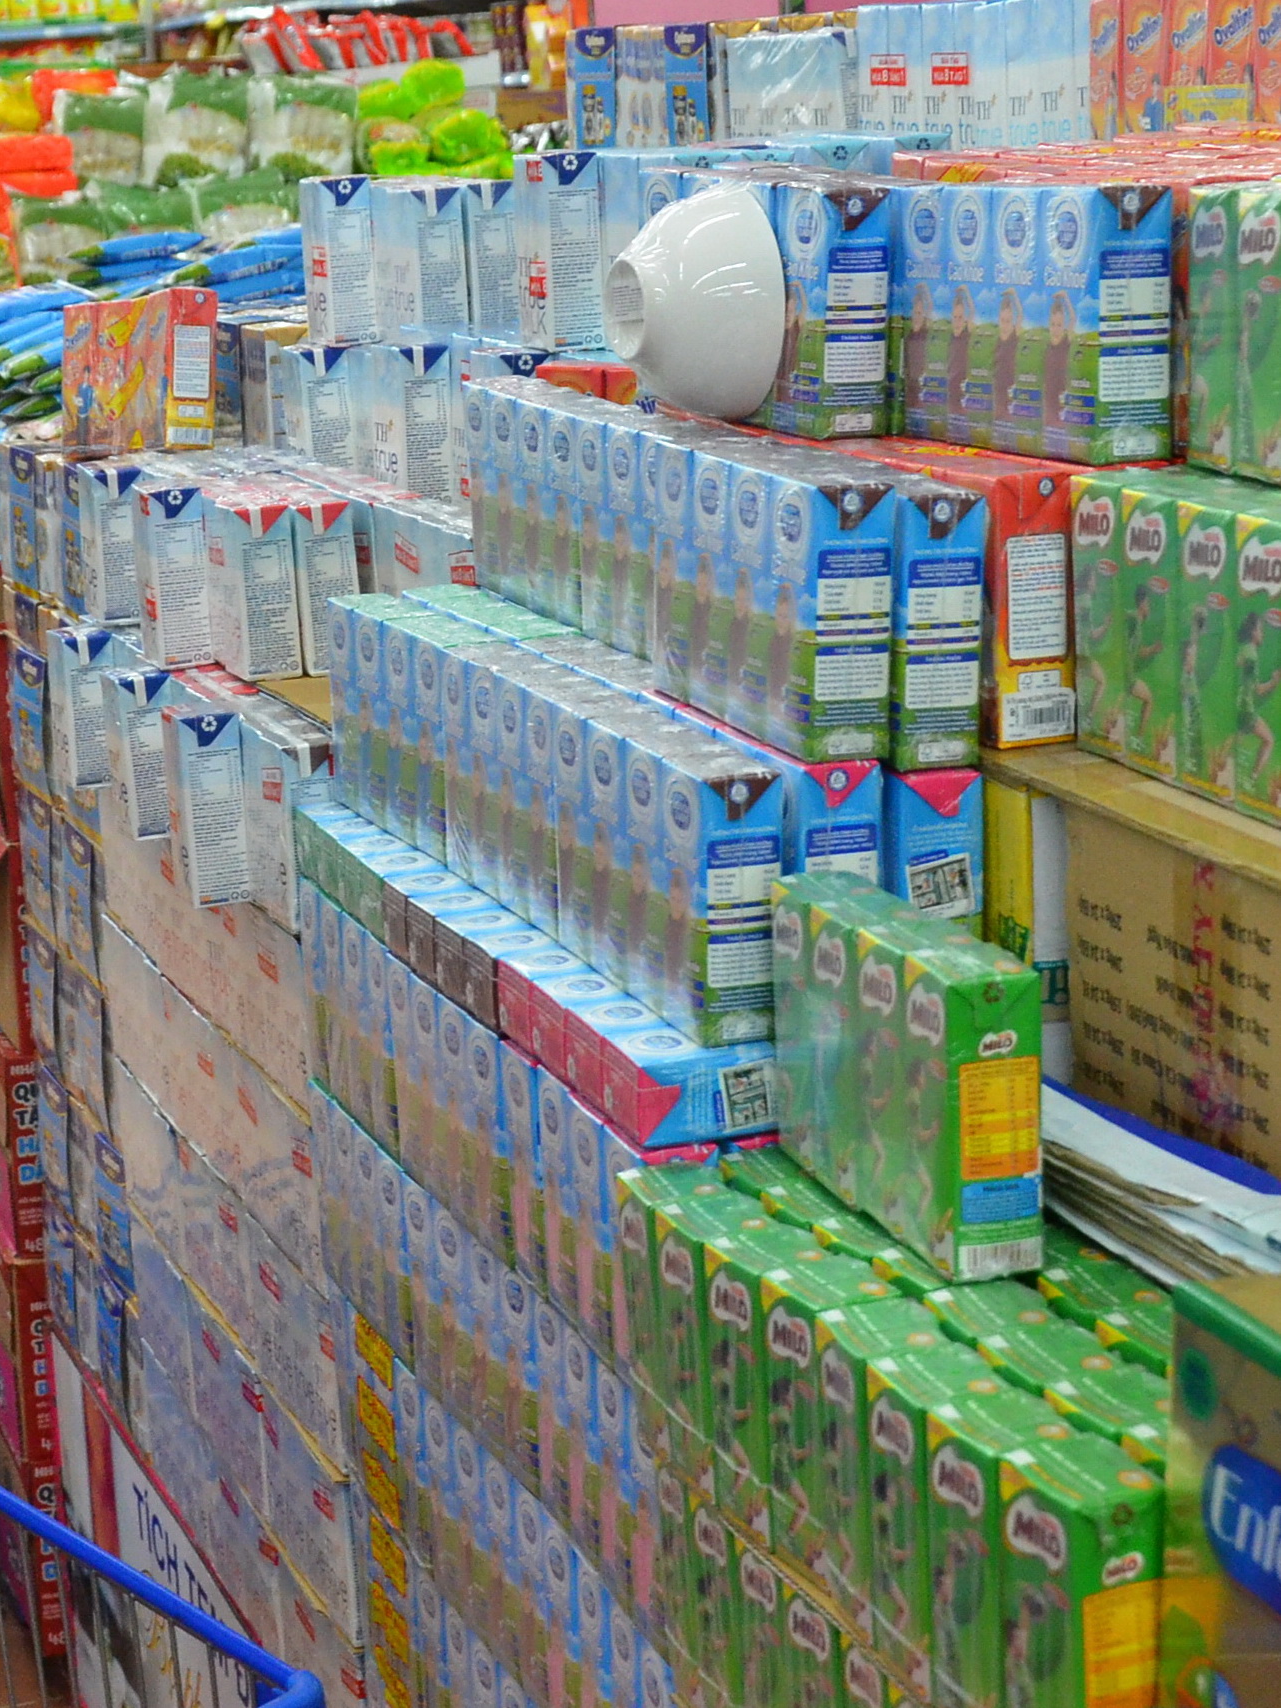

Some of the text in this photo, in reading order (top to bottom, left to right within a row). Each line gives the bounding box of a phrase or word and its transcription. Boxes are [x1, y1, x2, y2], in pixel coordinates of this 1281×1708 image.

[1127, 13, 1163, 53] Ovaltine
[1214, 6, 1254, 47] Ovaltine
[893, 95, 907, 114] TH
[925, 95, 940, 115] TH
[1010, 96, 1026, 116] TH
[1041, 91, 1058, 112] TH
[1077, 86, 1087, 107] T
[976, 100, 991, 120] TH
[1240, 227, 1276, 255] MILO
[375, 422, 389, 443] TH
[374, 448, 399, 474] true
[1079, 512, 1110, 536] MILO
[1130, 527, 1161, 552] MILO
[1188, 541, 1220, 567] MILO
[861, 975, 892, 1005] MILO
[983, 1036, 1013, 1052] MILO
[714, 1285, 748, 1323] MILO
[772, 1319, 808, 1360] MILO
[938, 1460, 979, 1508] MILO
[1013, 1510, 1061, 1561] MILO
[792, 1610, 827, 1652] MILO
